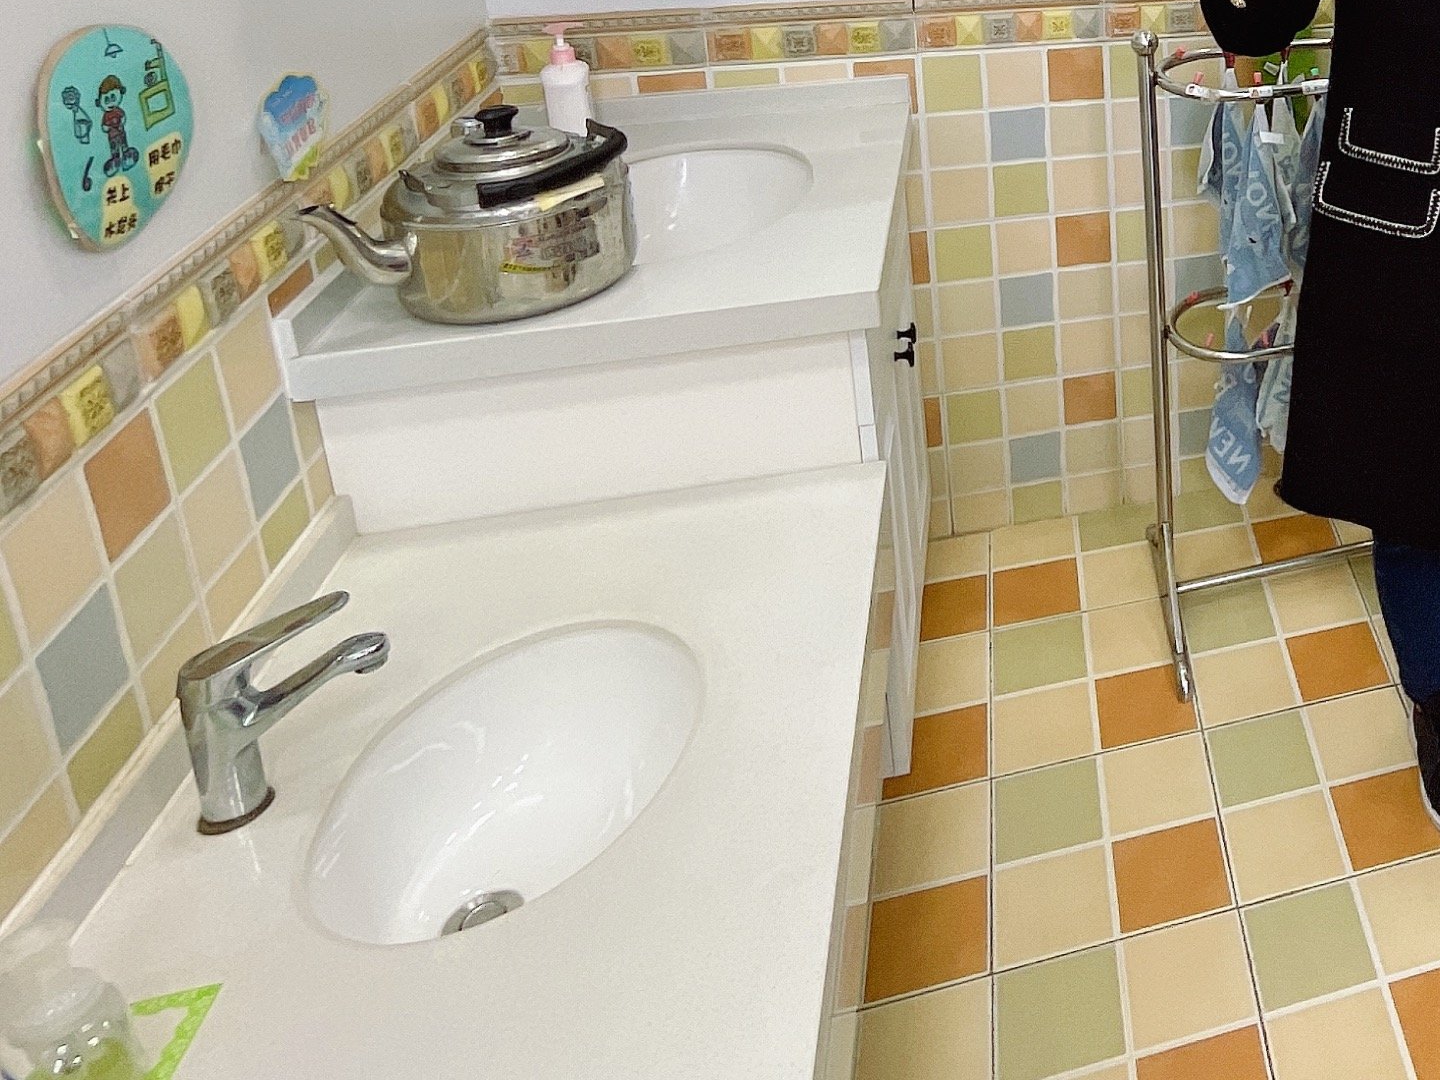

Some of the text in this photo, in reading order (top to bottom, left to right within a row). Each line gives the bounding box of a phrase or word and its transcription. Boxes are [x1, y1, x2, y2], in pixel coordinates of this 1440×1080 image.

[149, 138, 182, 167] 用毛巾
[106, 183, 130, 206] 关上
[104, 212, 138, 239] 水龙头
